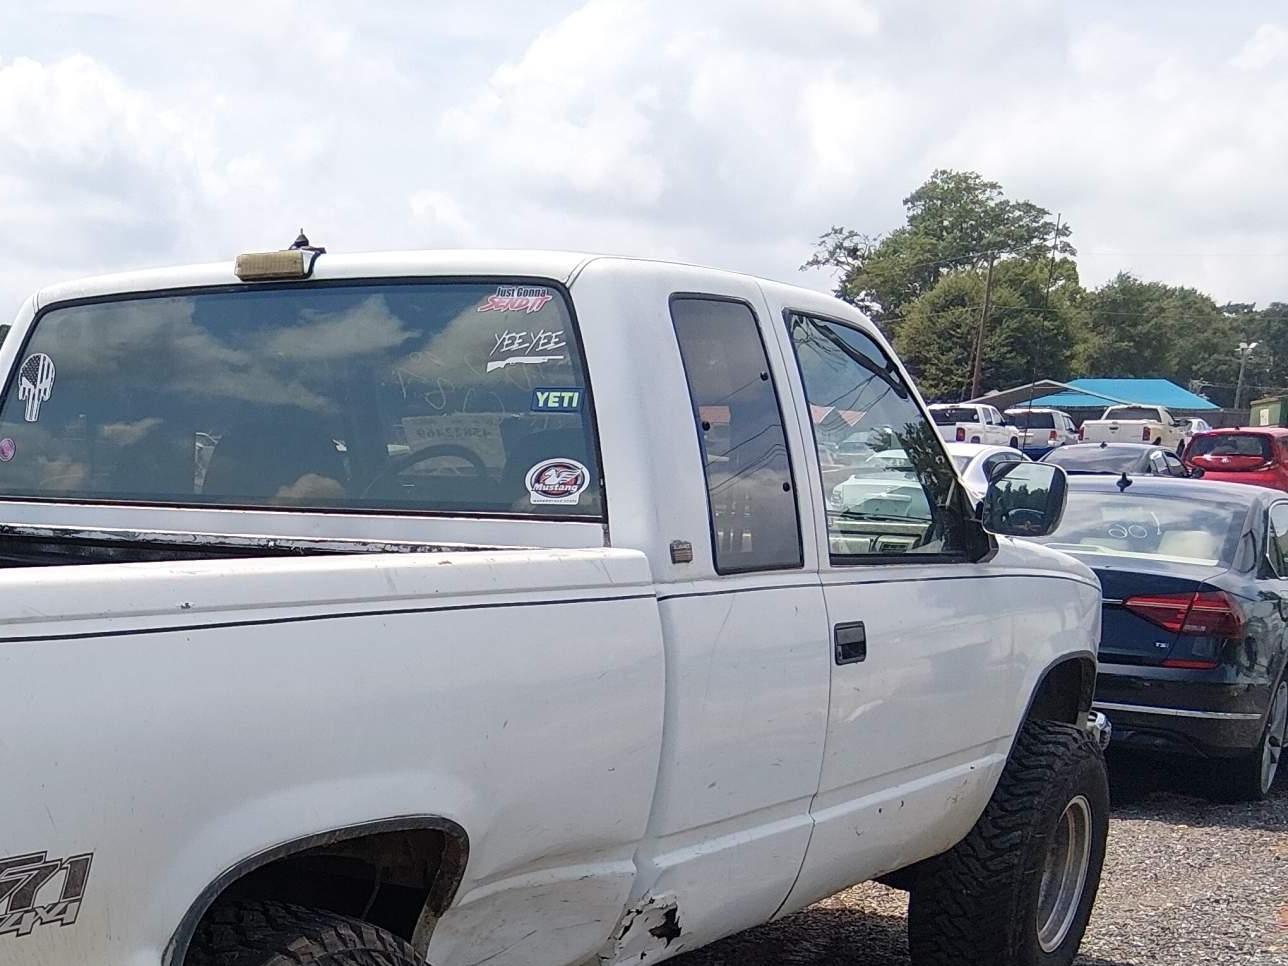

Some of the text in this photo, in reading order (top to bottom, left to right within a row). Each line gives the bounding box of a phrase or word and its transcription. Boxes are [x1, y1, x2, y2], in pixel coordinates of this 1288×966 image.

[496, 287, 547, 298] Just Gonna
[490, 329, 566, 356] YEE YEE
[536, 392, 579, 408] YETI
[532, 483, 578, 493] Mustang
